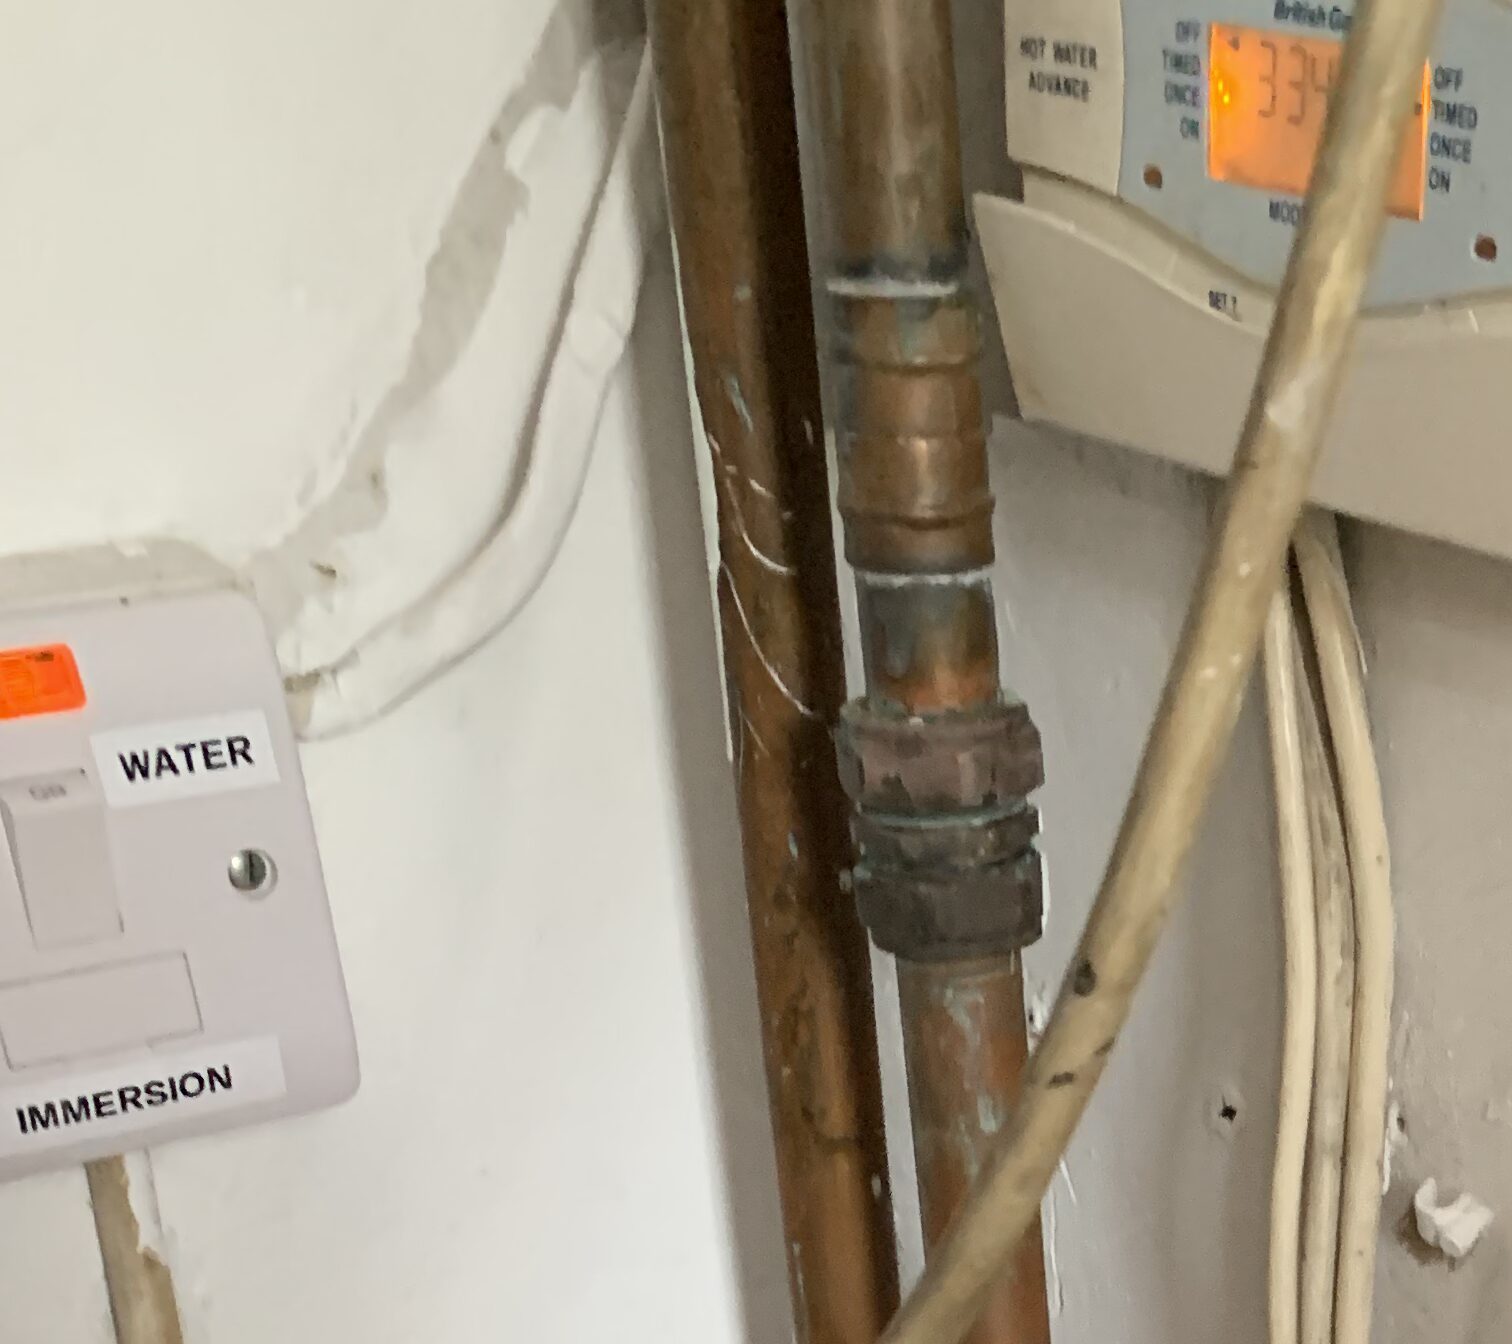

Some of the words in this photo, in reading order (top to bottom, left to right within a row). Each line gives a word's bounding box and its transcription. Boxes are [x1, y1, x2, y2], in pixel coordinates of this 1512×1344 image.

[1020, 36, 1047, 60] HOT
[1053, 41, 1098, 70] WATER
[1028, 71, 1090, 103] ADVANCE
[1433, 65, 1463, 91] OFF
[1431, 100, 1478, 129] TIMED
[1430, 134, 1471, 162] ONCE
[1428, 167, 1450, 192] ON
[118, 735, 255, 783] WATER
[16, 1064, 234, 1134] IMMERSION
